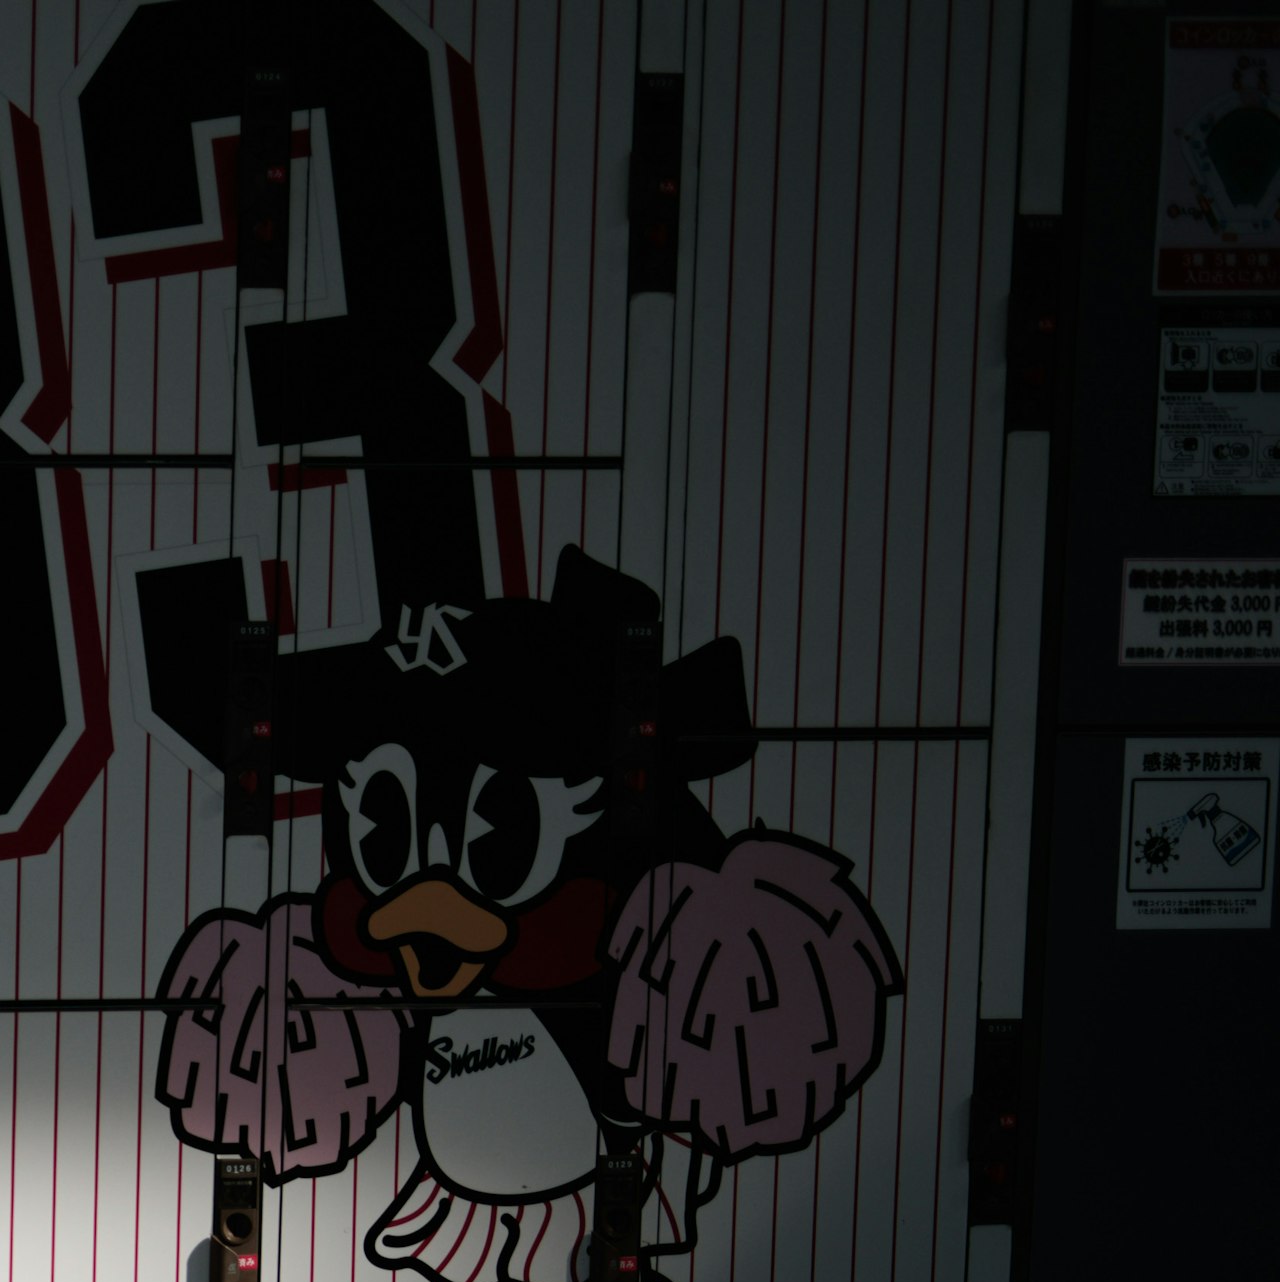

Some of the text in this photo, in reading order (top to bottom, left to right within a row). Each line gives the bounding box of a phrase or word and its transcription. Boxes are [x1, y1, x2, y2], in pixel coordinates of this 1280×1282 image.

[1230, 596, 1271, 614] 3,000
[1159, 620, 1273, 638] 出張料 3,000 円
[1142, 752, 1263, 772] 感染予防対策
[425, 1033, 536, 1084] Swallows
[226, 1164, 252, 1174] 0126
